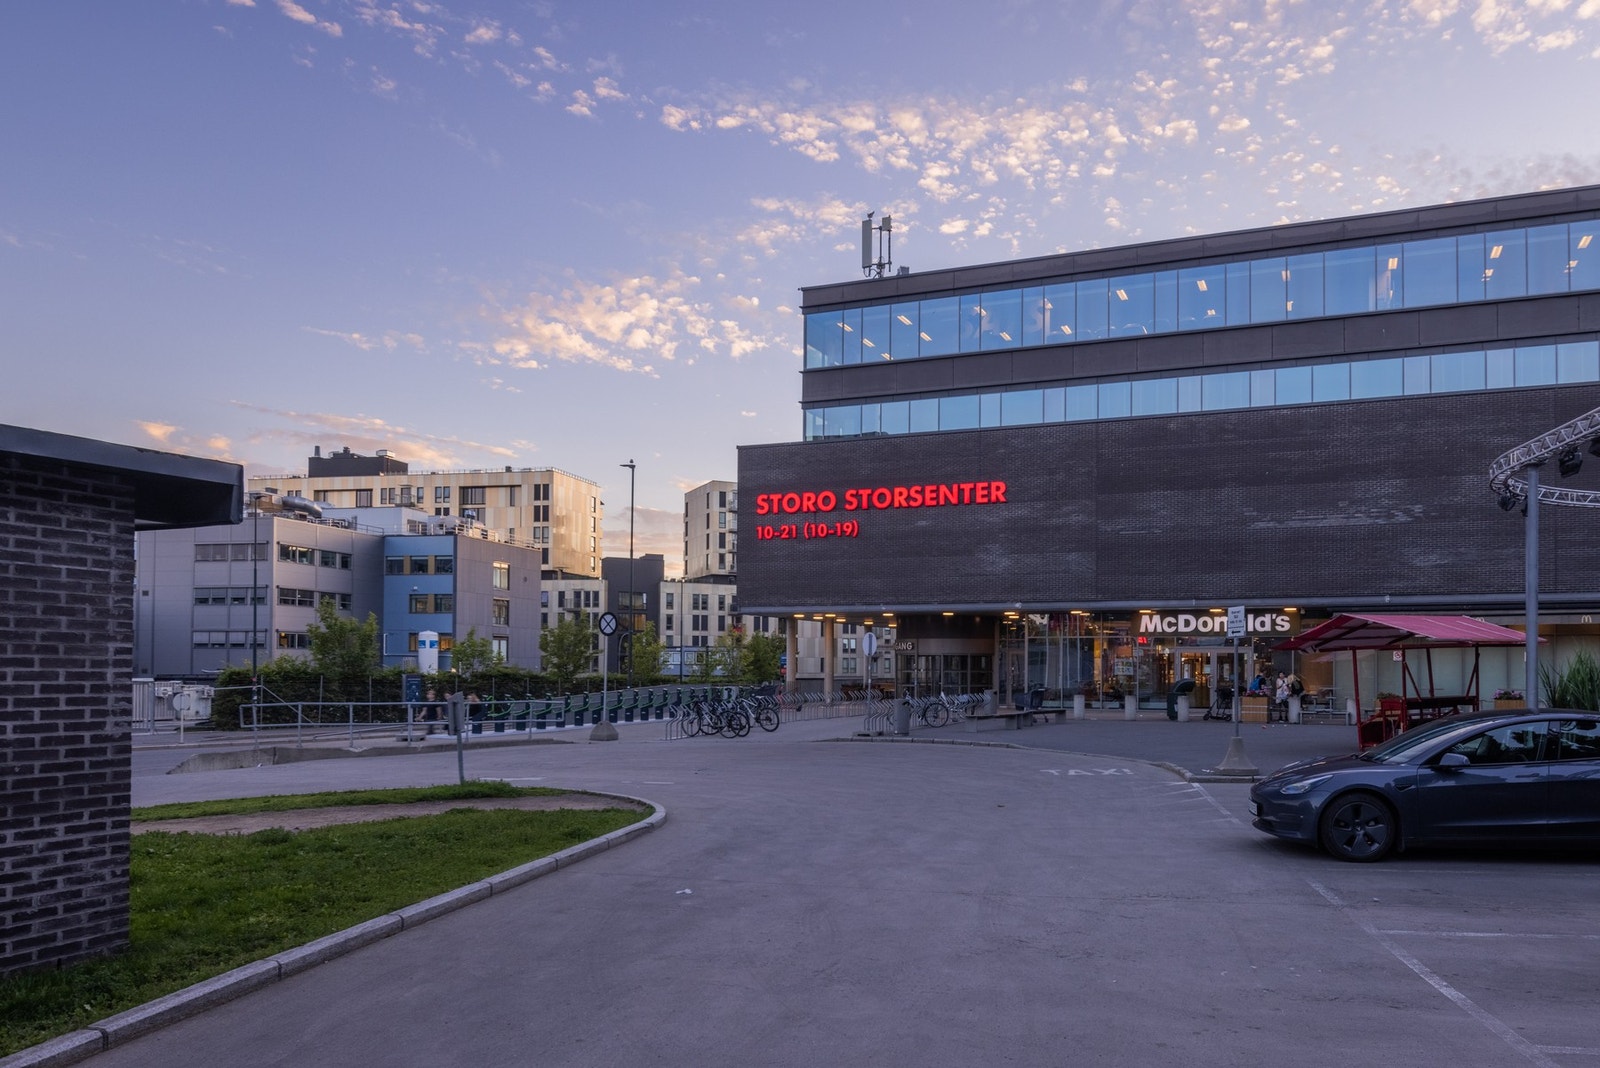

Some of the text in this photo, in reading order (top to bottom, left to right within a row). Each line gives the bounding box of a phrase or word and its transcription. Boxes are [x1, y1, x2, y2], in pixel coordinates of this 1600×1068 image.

[756, 481, 1008, 515] STORO STORSENTER
[756, 519, 859, 540] 10-21 (10-19)
[1139, 613, 1290, 633] McDonld's
